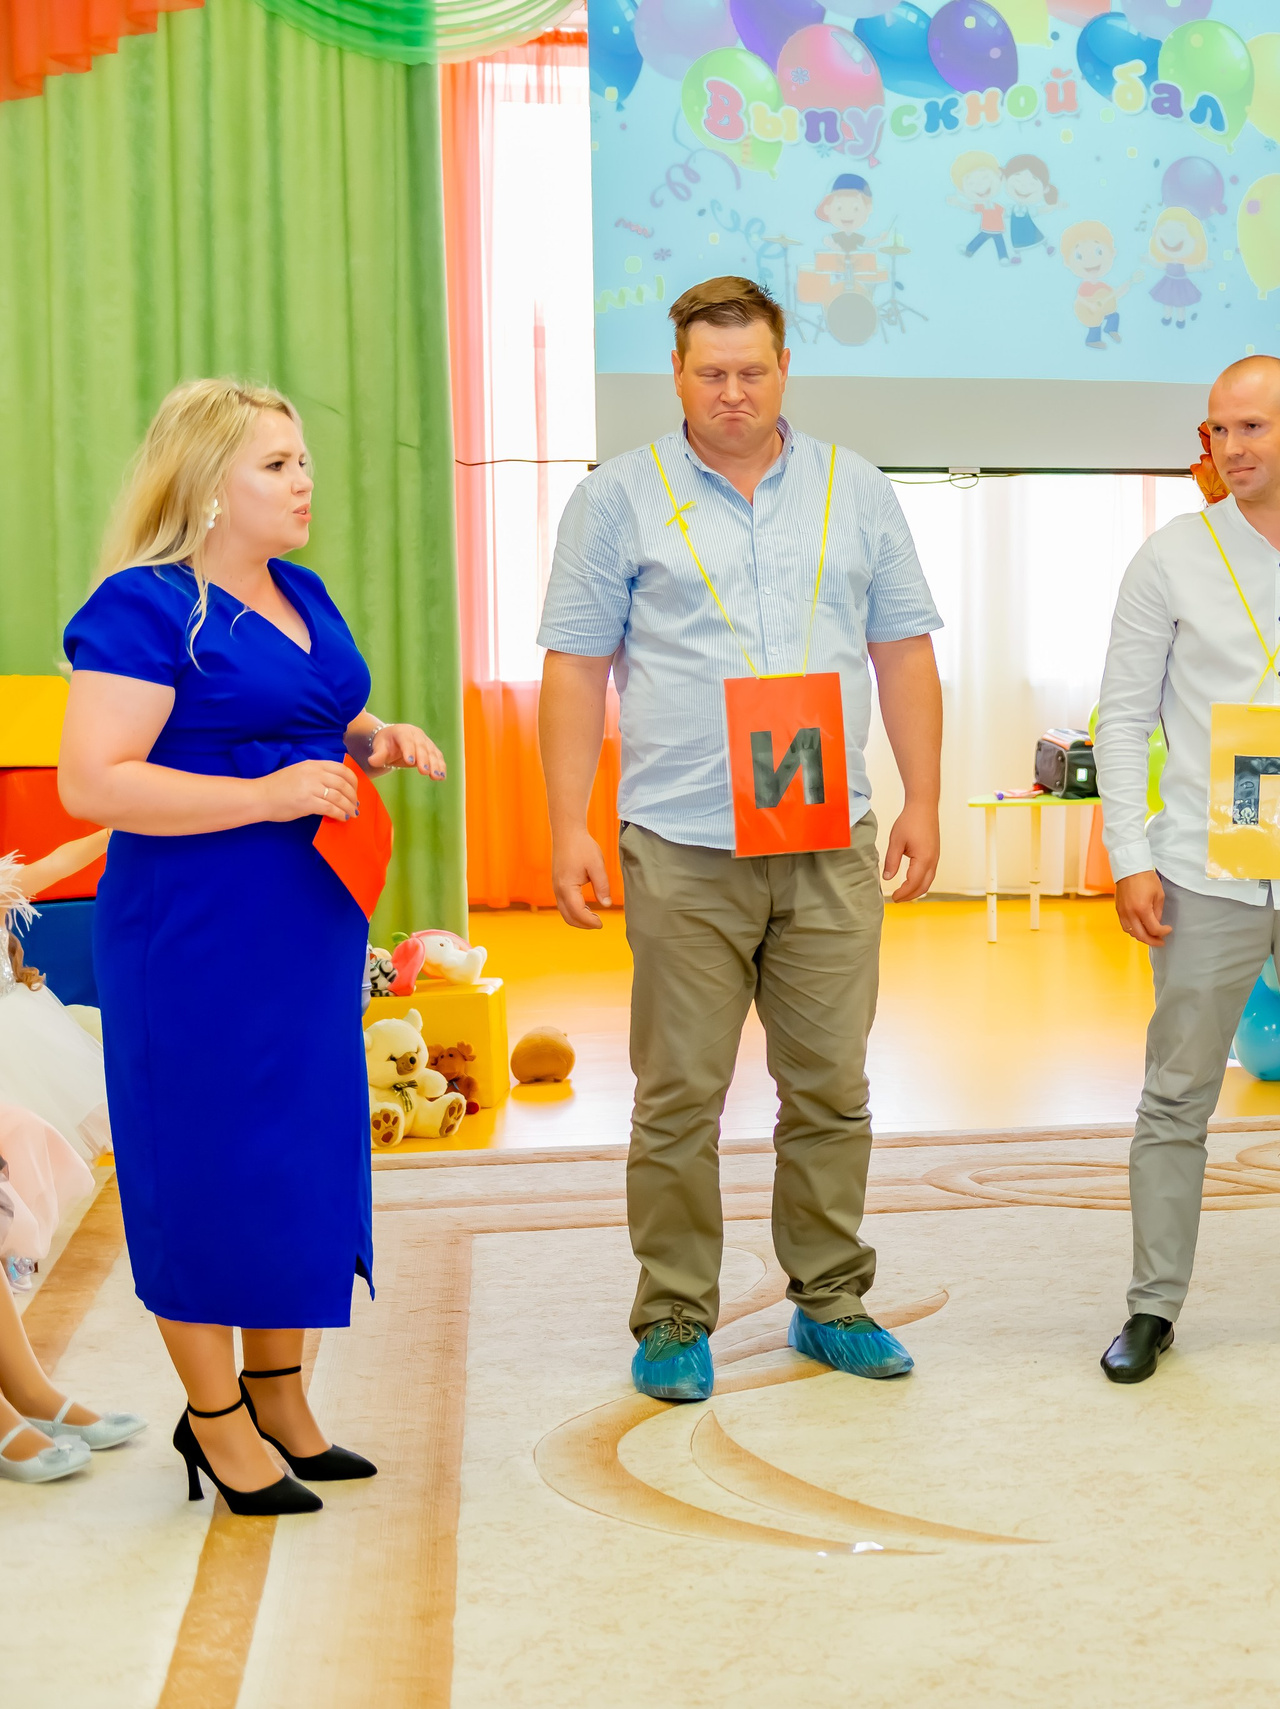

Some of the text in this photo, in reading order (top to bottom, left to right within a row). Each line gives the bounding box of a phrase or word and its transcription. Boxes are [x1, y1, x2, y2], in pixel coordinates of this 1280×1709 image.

[704, 60, 1228, 158] Выпускной бал
[750, 727, 825, 810] И
